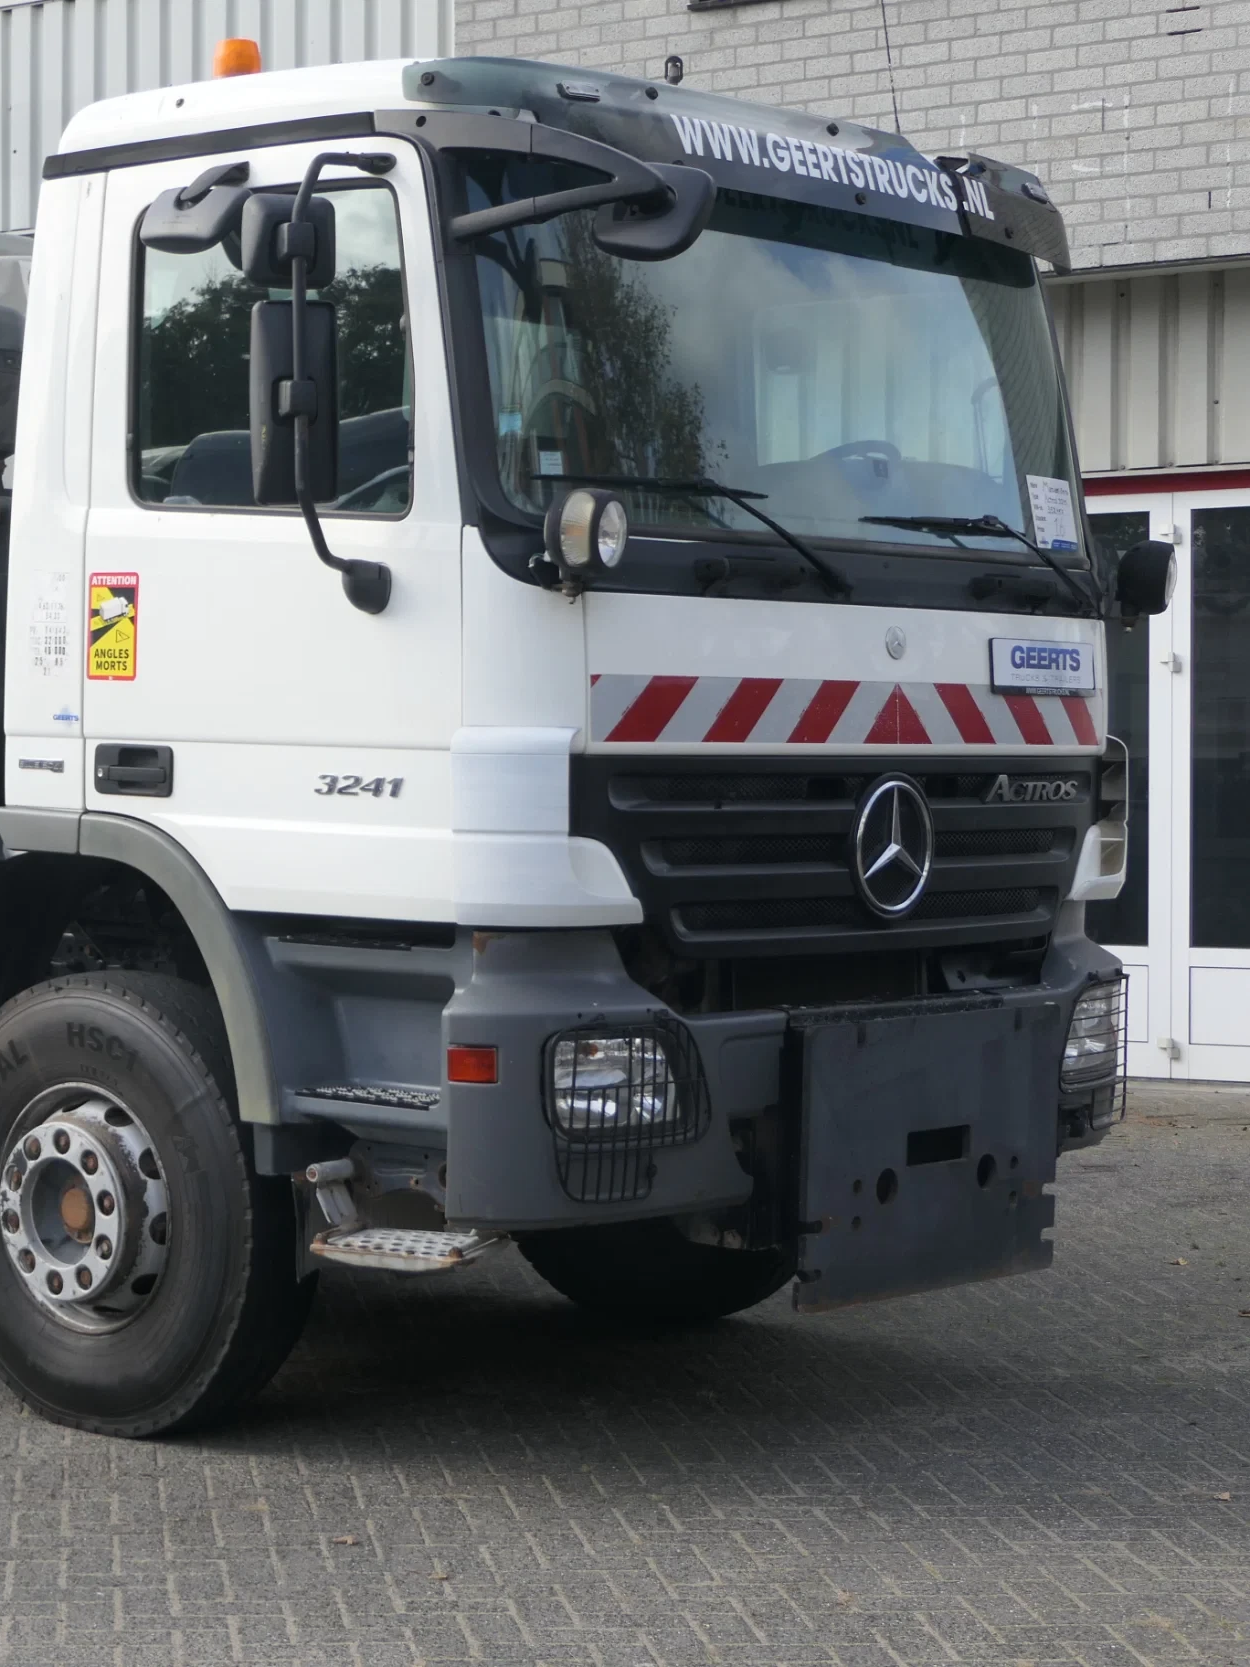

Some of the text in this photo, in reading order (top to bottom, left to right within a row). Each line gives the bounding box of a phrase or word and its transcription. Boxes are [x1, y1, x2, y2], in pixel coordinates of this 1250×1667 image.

[670, 113, 995, 222] WWW.GEERTSTRUCKS.NL
[91, 575, 137, 586] ATTENTION
[93, 648, 130, 659] ANGLES
[1009, 644, 1082, 673] GEERTS
[95, 660, 128, 671] MORTS
[1010, 673, 1040, 683] TRUCKS
[313, 774, 405, 798] 3241
